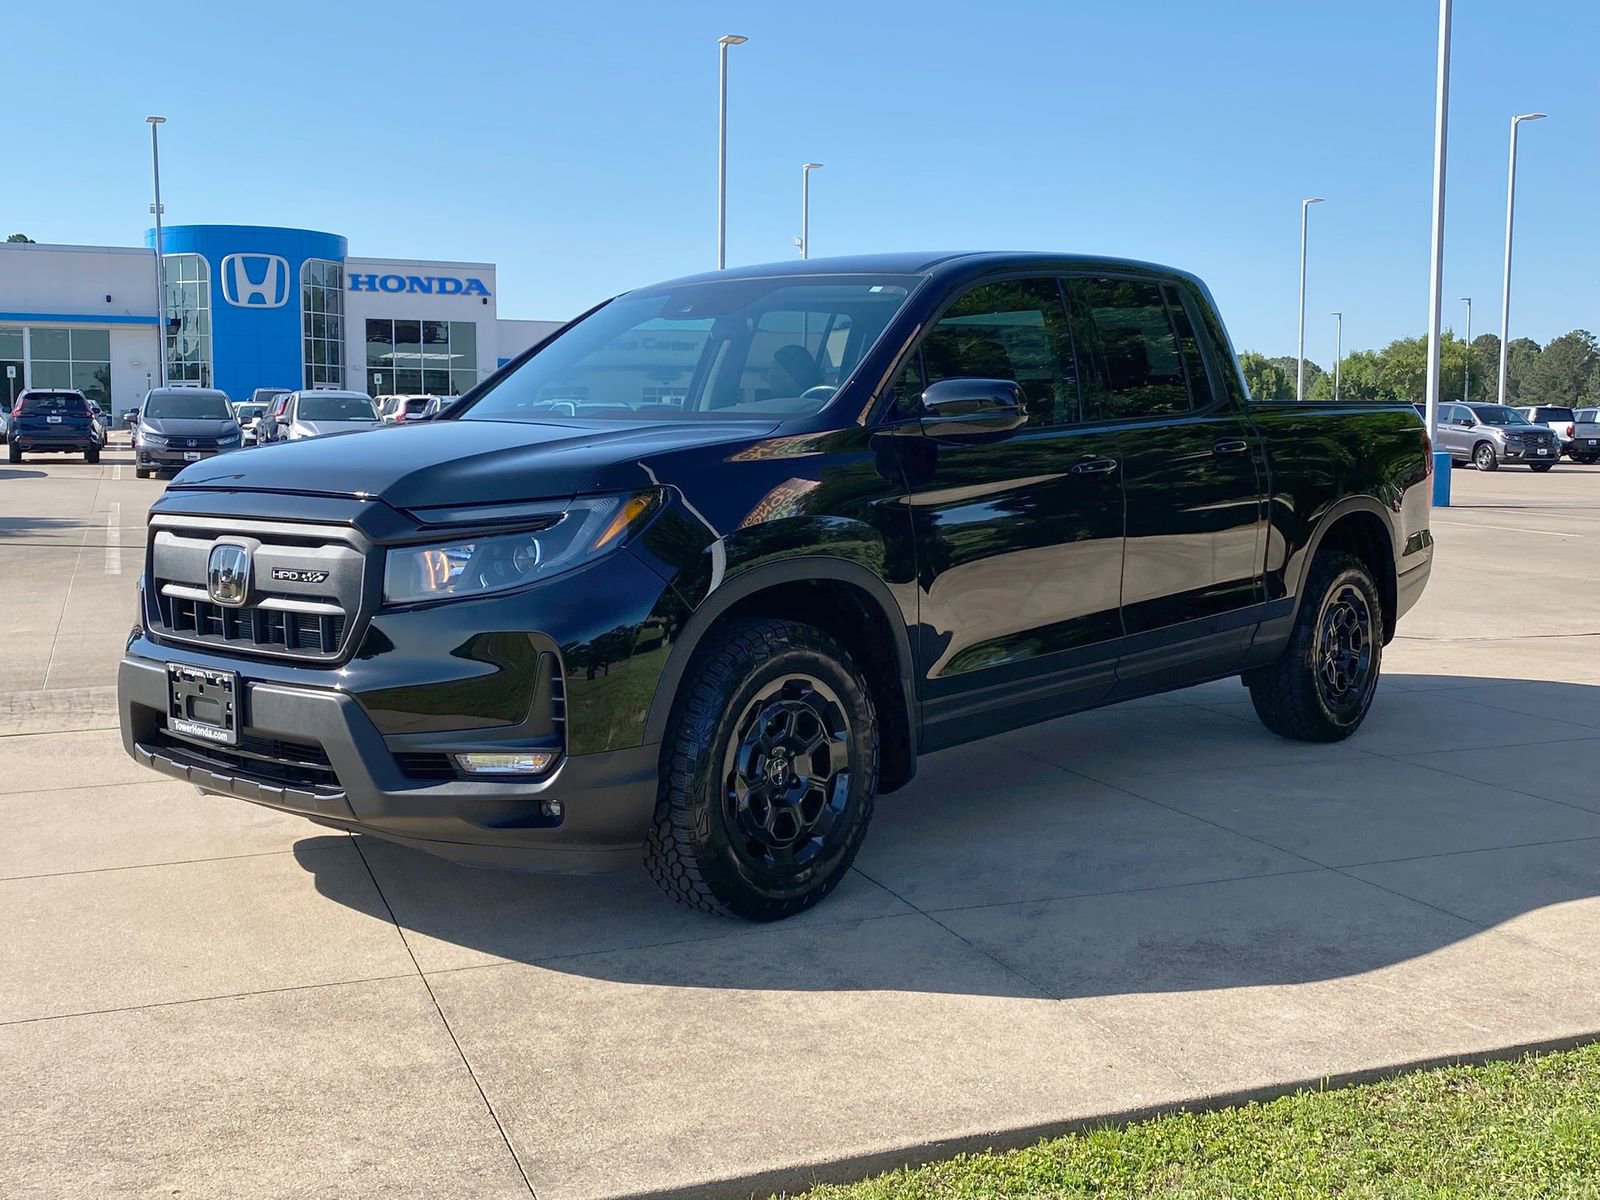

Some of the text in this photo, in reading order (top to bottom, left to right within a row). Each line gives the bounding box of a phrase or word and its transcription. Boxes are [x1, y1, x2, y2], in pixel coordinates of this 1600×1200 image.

[348, 273, 492, 296] HONDA
[272, 570, 299, 580] HPD
[174, 720, 228, 742] TowerHonda.com
